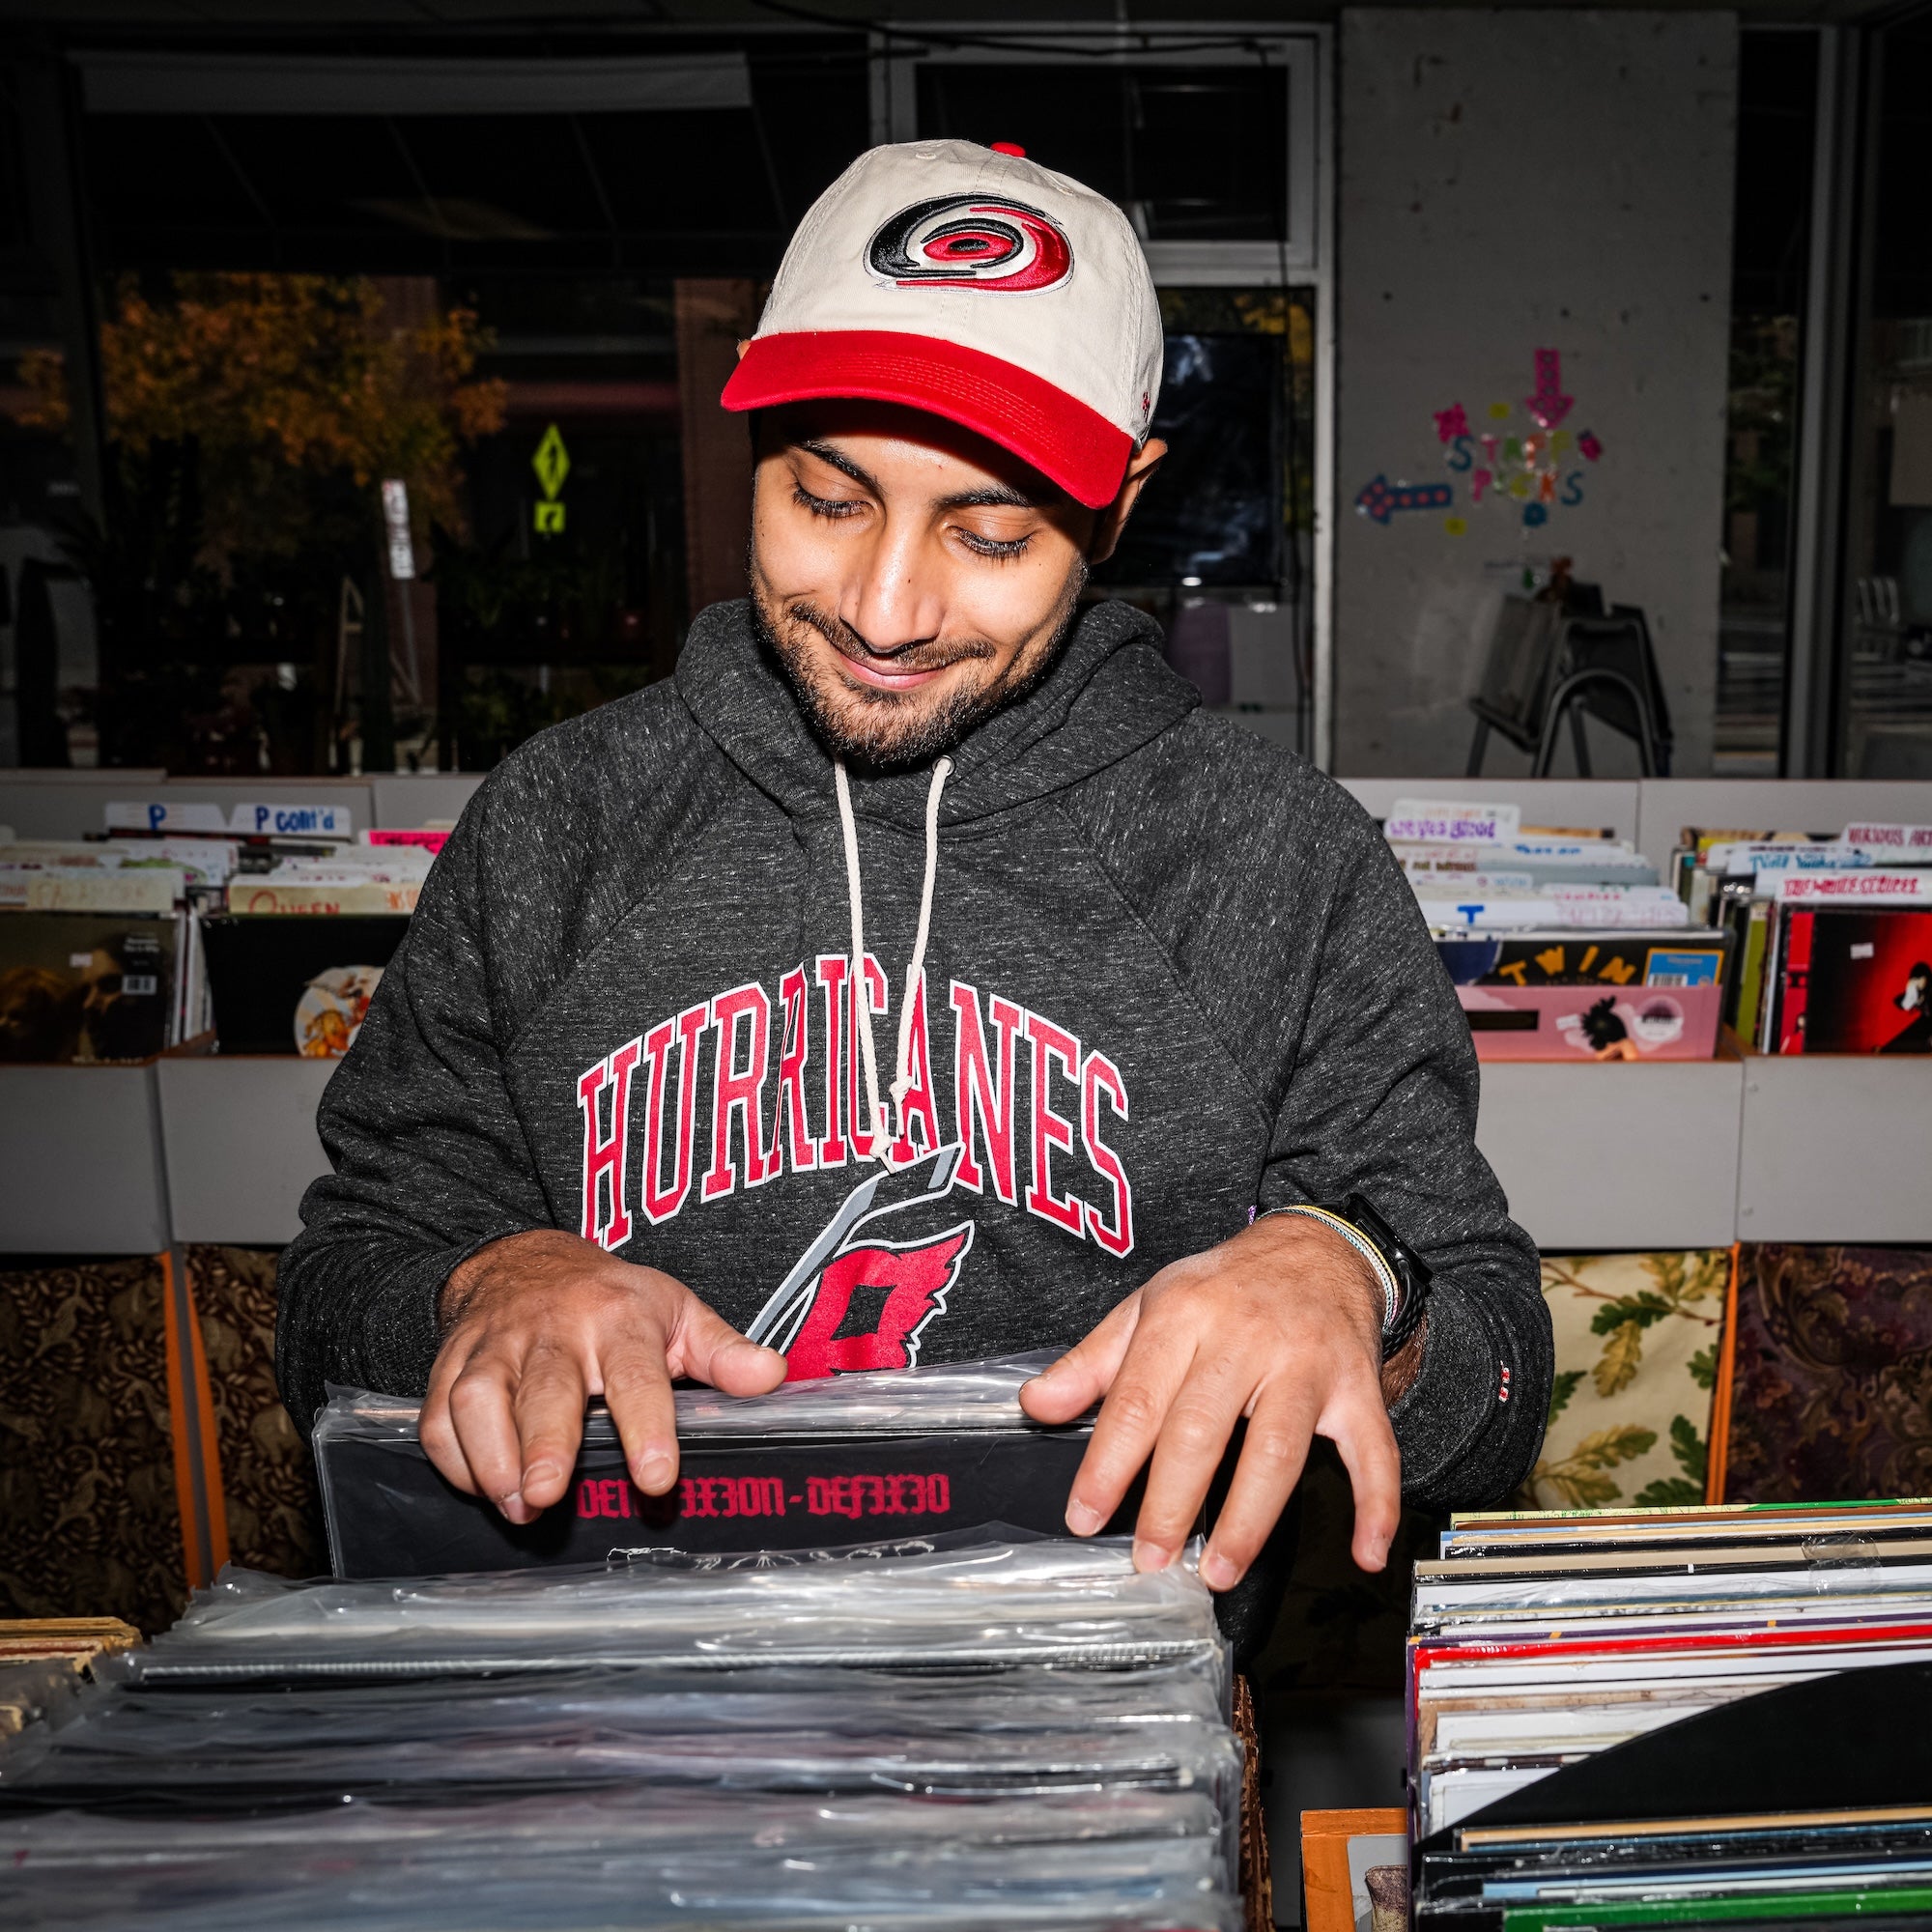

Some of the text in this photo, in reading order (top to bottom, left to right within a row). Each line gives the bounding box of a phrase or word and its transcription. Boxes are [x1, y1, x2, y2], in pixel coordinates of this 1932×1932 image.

[149, 805, 166, 830] P
[255, 806, 270, 831] P
[1457, 904, 1485, 924] T
[1498, 945, 1636, 986] TWIN
[577, 952, 1135, 1259] HURRICANES
